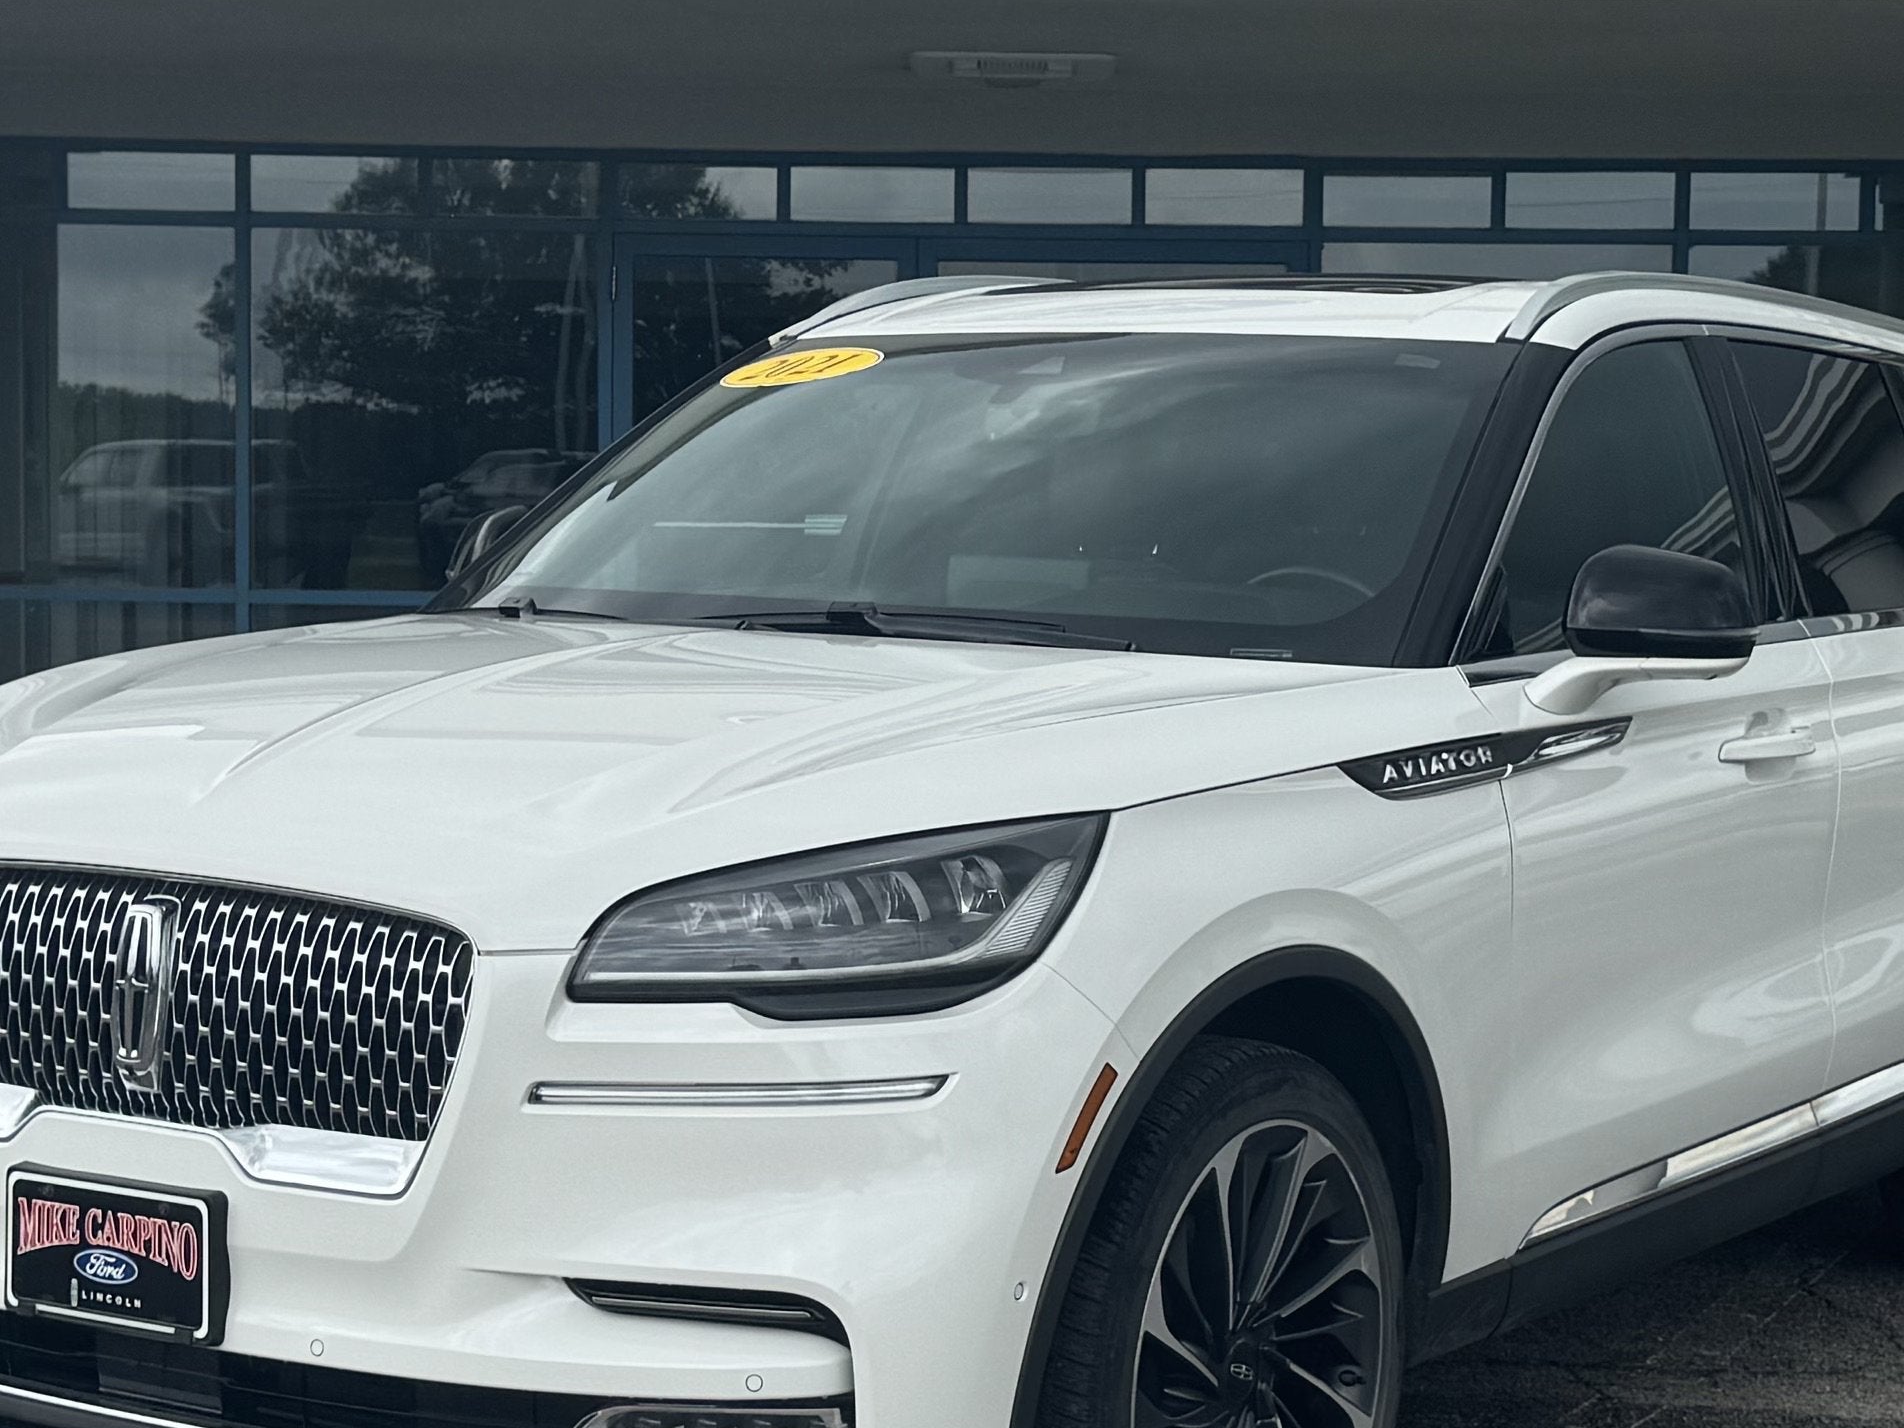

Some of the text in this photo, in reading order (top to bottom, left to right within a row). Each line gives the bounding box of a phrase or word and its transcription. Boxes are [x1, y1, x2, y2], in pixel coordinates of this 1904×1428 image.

[738, 353, 864, 382] 2021
[1382, 745, 1494, 784] AVIATOR
[16, 1197, 198, 1281] MIKE CARPINO
[85, 1253, 126, 1279] Ford
[81, 1289, 142, 1309] LINCOLN
